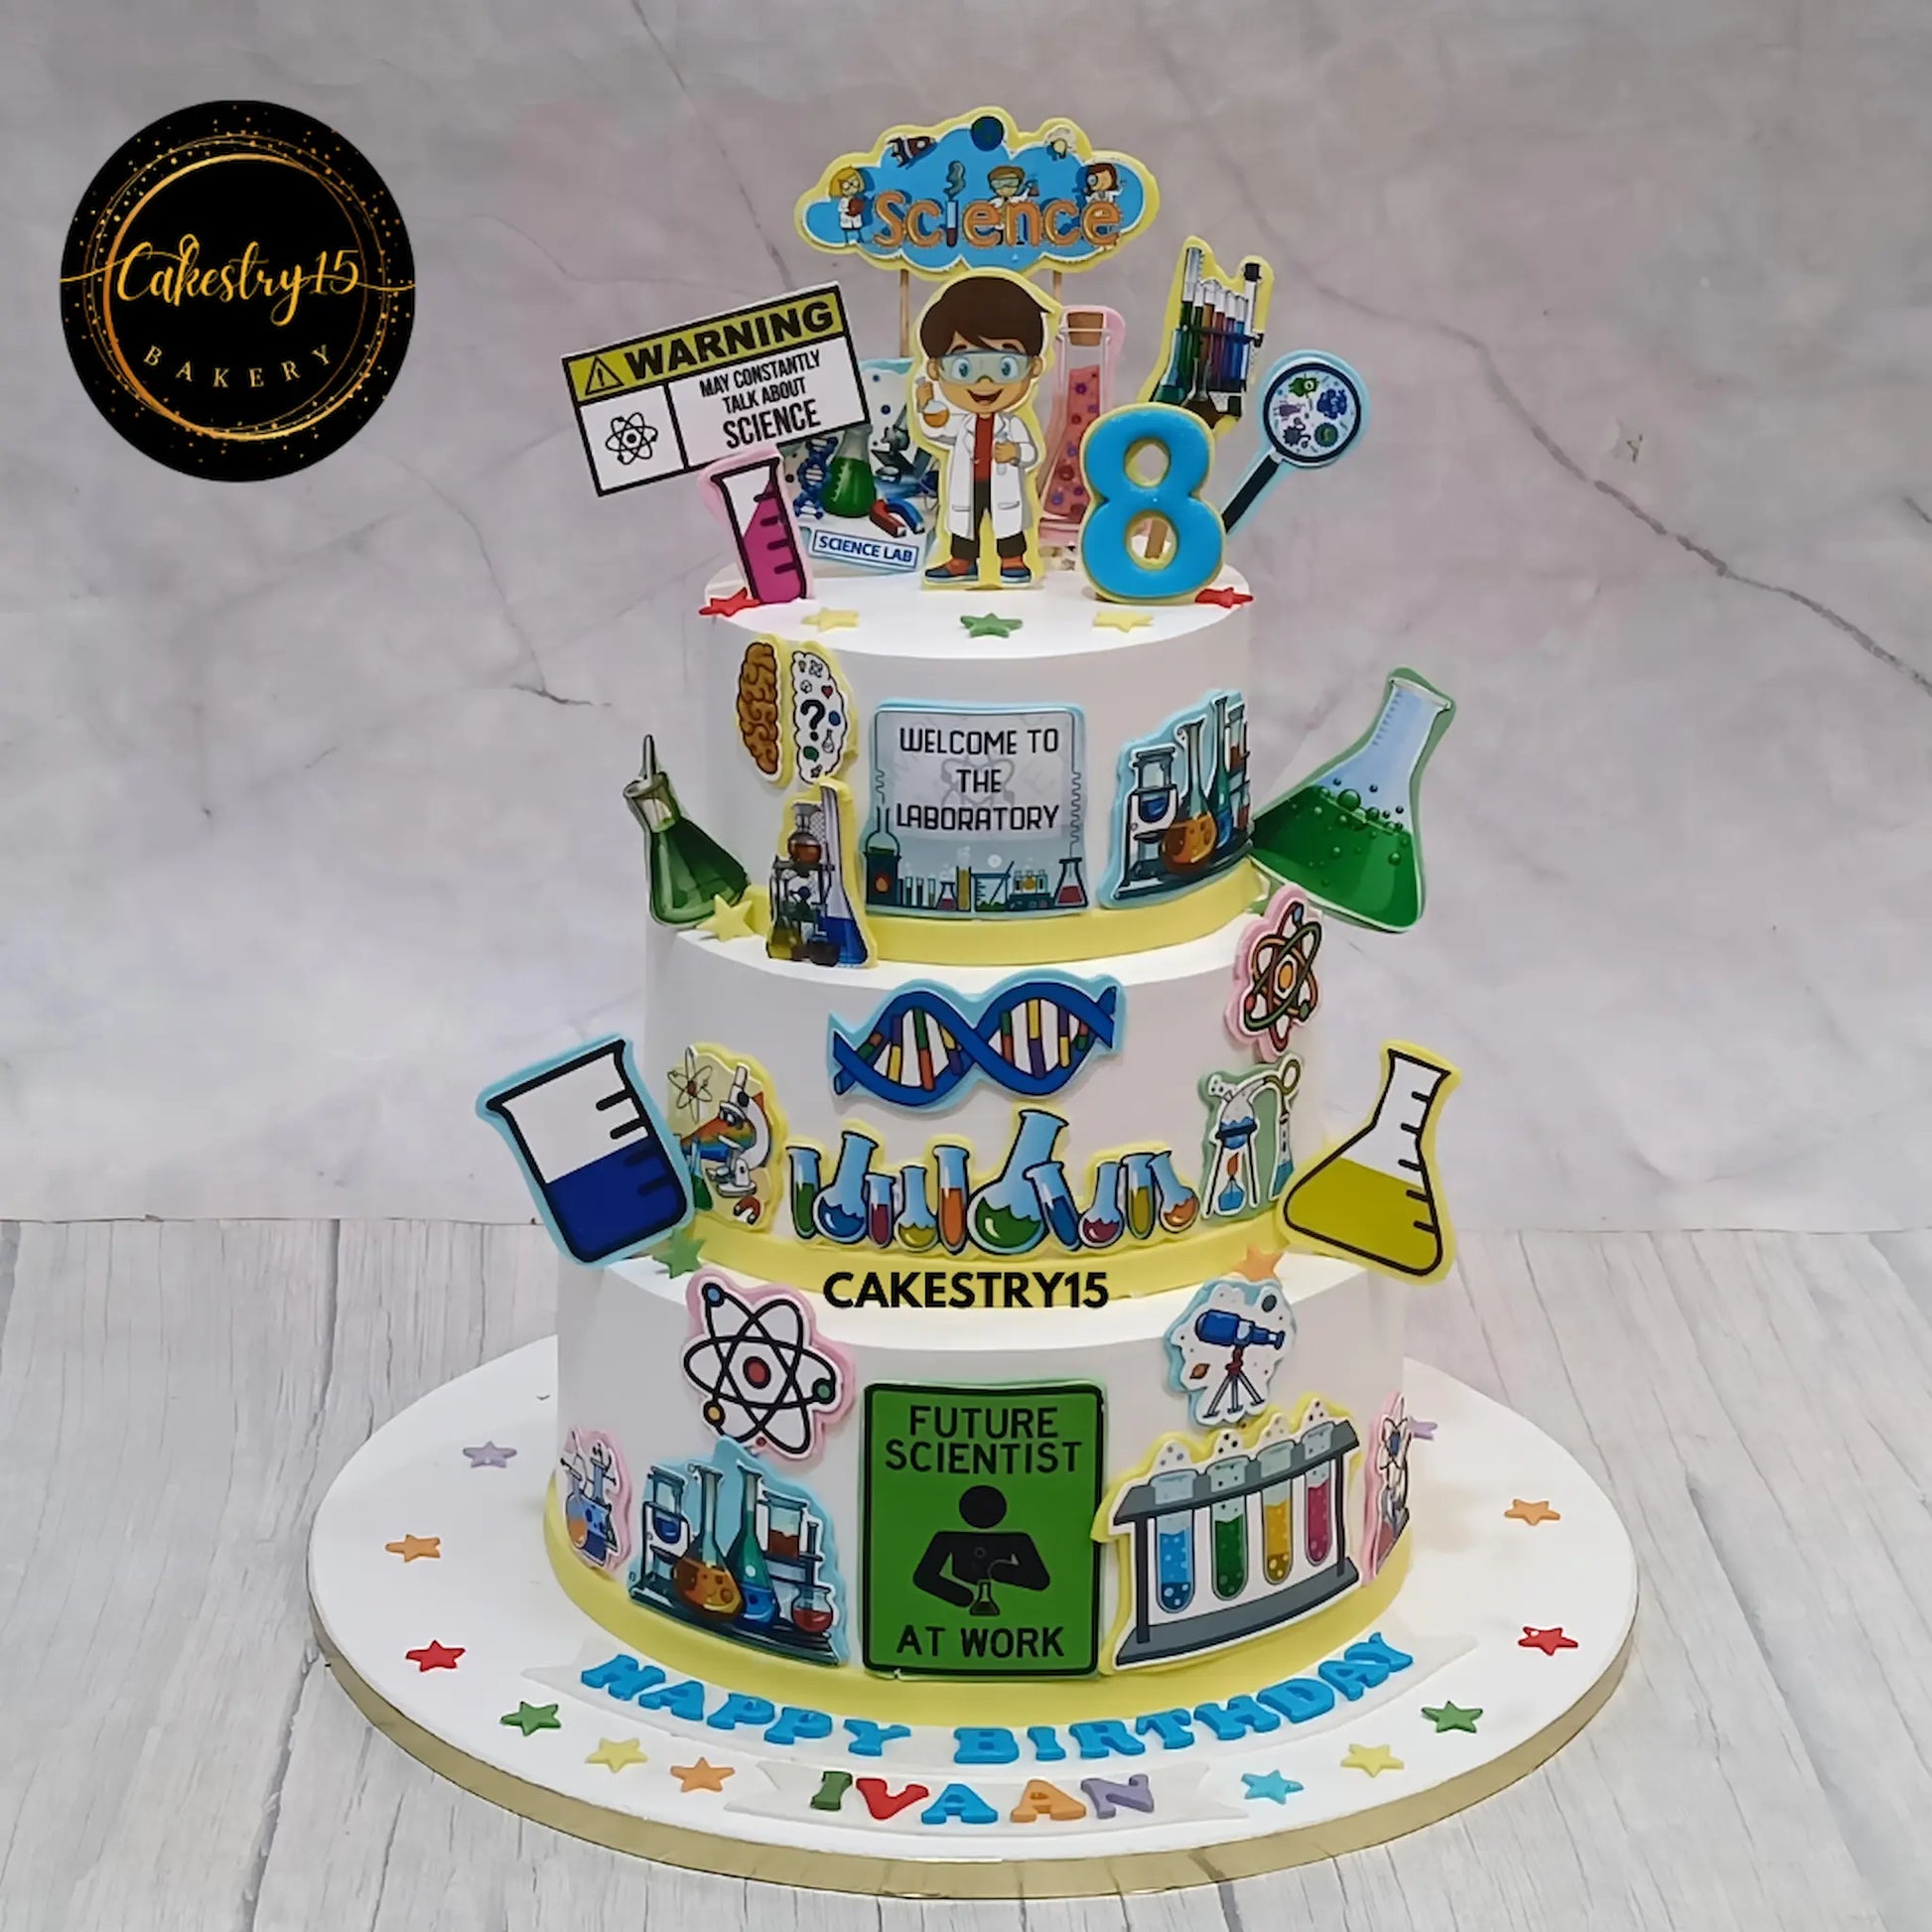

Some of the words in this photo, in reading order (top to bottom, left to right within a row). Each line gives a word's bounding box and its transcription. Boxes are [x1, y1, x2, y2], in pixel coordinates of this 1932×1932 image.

[872, 191, 1124, 249] Science
[624, 301, 834, 380] WARNING
[699, 371, 733, 397] MAY
[733, 349, 821, 389] CONSTANTLY
[723, 391, 759, 414] TALK
[761, 376, 807, 404] ABOUT
[723, 399, 821, 449] SCIENCE
[1082, 408, 1223, 598] 8
[819, 535, 881, 558] SCIENCE
[884, 546, 912, 563] LAB
[898, 728, 1018, 756] WELCOME
[1027, 728, 1059, 754] TO
[956, 768, 1002, 793] THE
[896, 803, 1059, 831] LABORATORY
[909, 1405, 1058, 1439] FUTURE
[885, 1440, 1082, 1474] SCIENTIST
[897, 1624, 946, 1657] AT
[960, 1627, 1064, 1659] WORK
[581, 1653, 911, 1756] HAPPY
[953, 1631, 1414, 1764] BIRTHDAY
[809, 1770, 1155, 1825] IVAAN
